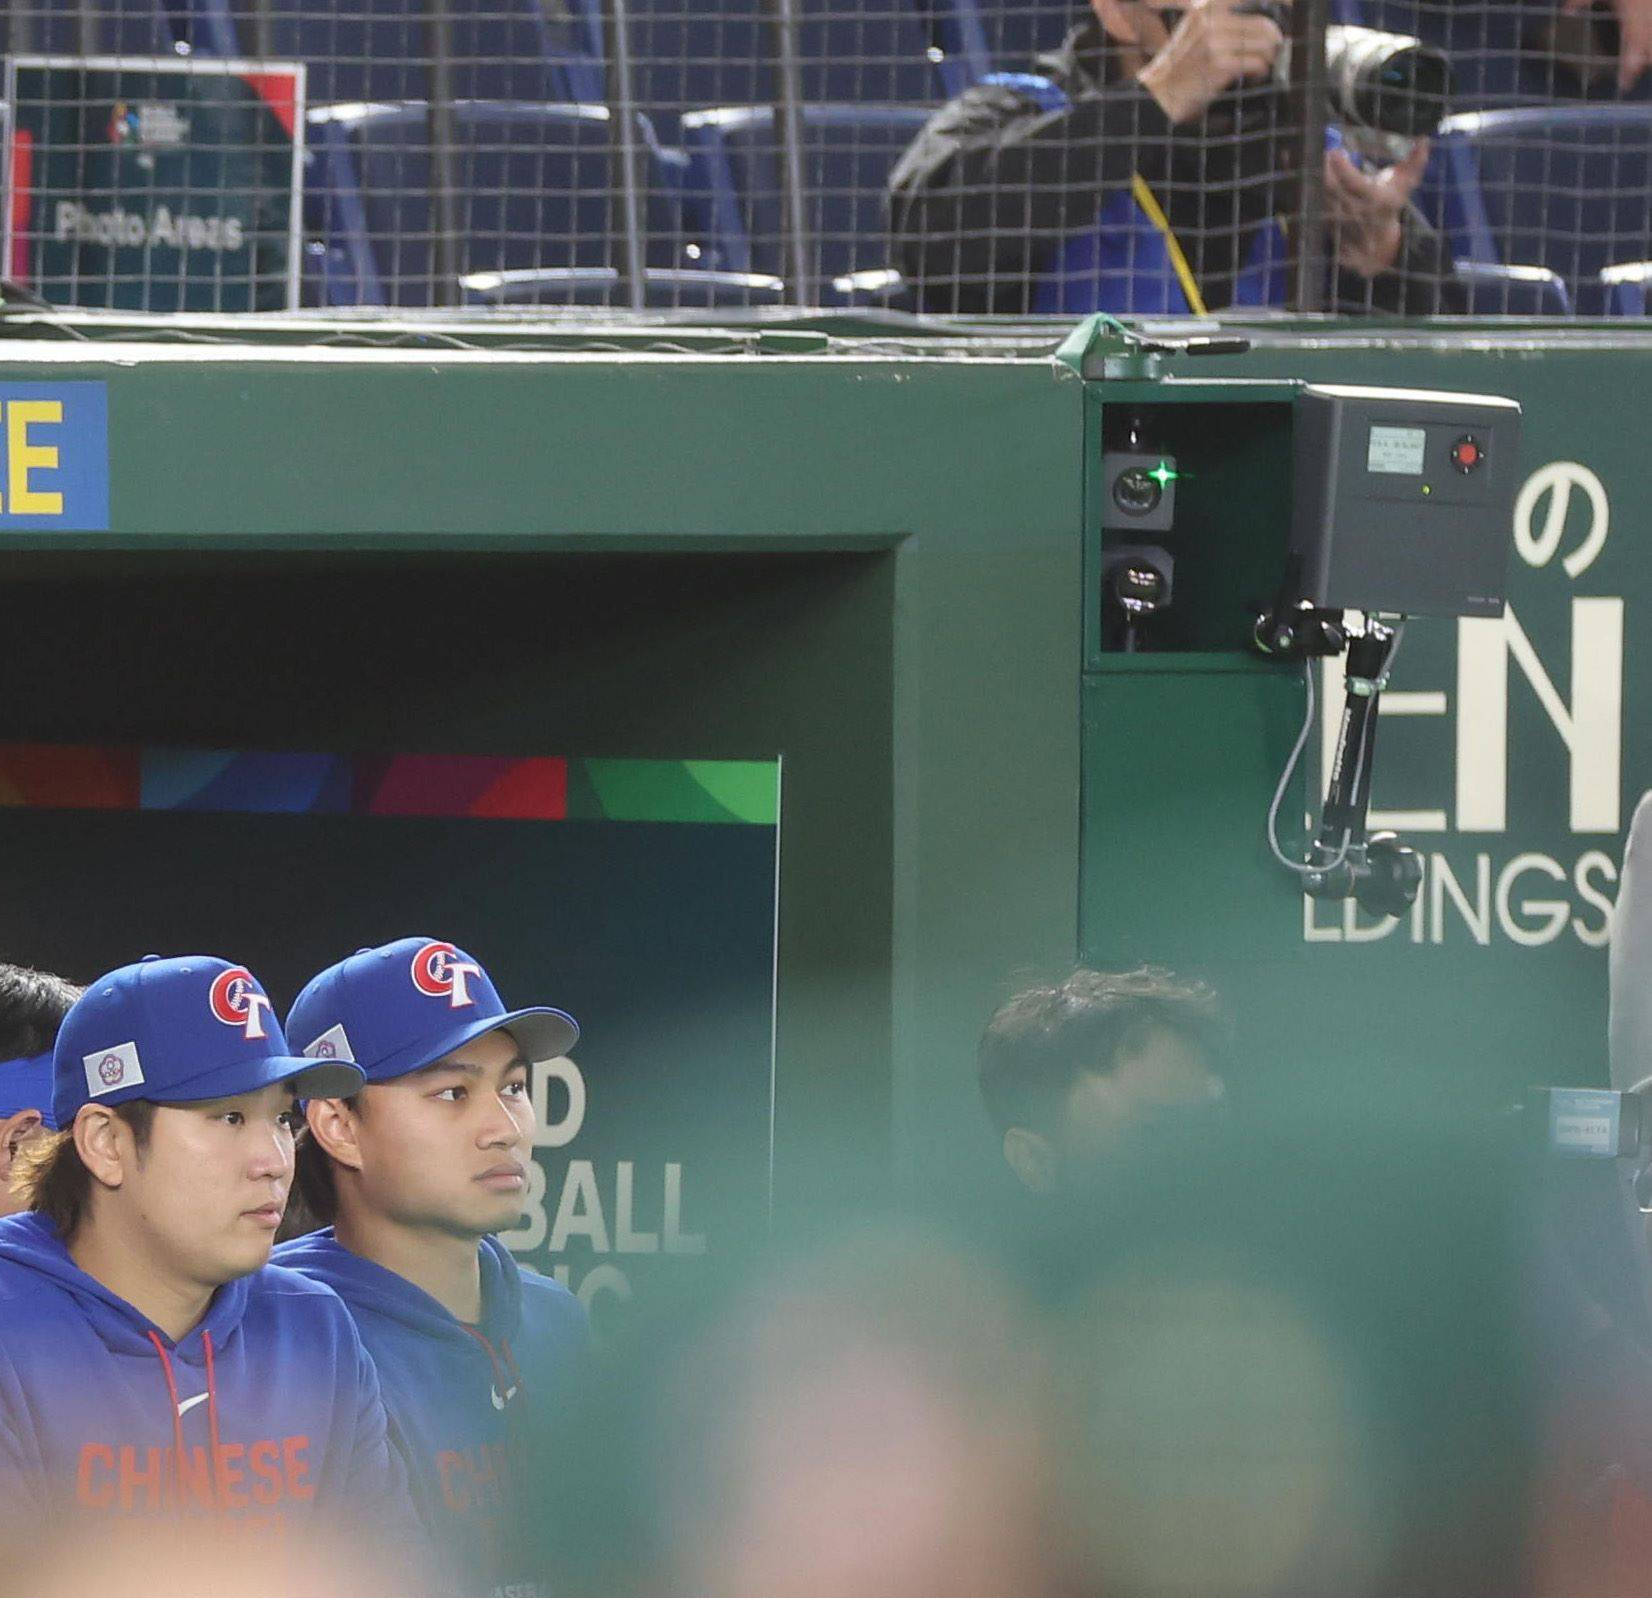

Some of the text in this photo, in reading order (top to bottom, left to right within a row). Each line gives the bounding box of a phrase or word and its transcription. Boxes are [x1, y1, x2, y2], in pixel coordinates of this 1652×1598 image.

[55, 200, 243, 250] Photo Areas
[1512, 461, 1610, 578] の
